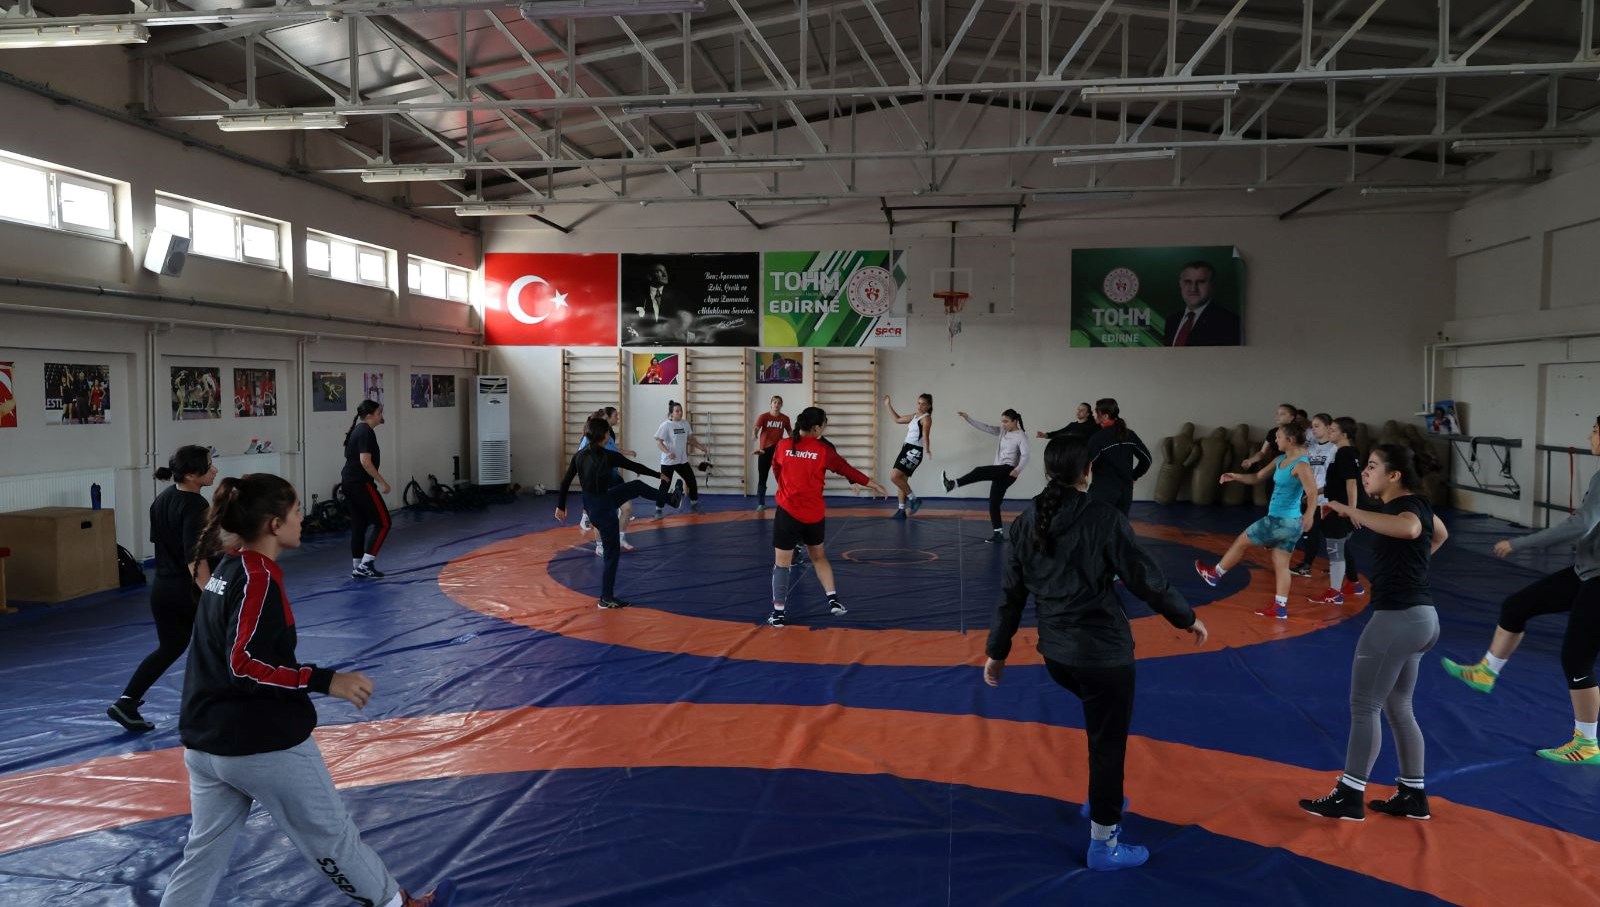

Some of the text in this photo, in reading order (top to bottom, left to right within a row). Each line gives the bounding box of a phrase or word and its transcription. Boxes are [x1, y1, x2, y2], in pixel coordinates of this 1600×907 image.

[770, 271, 841, 292] TOHM
[769, 297, 840, 314] EDİRNE
[1092, 307, 1151, 326] TOHM
